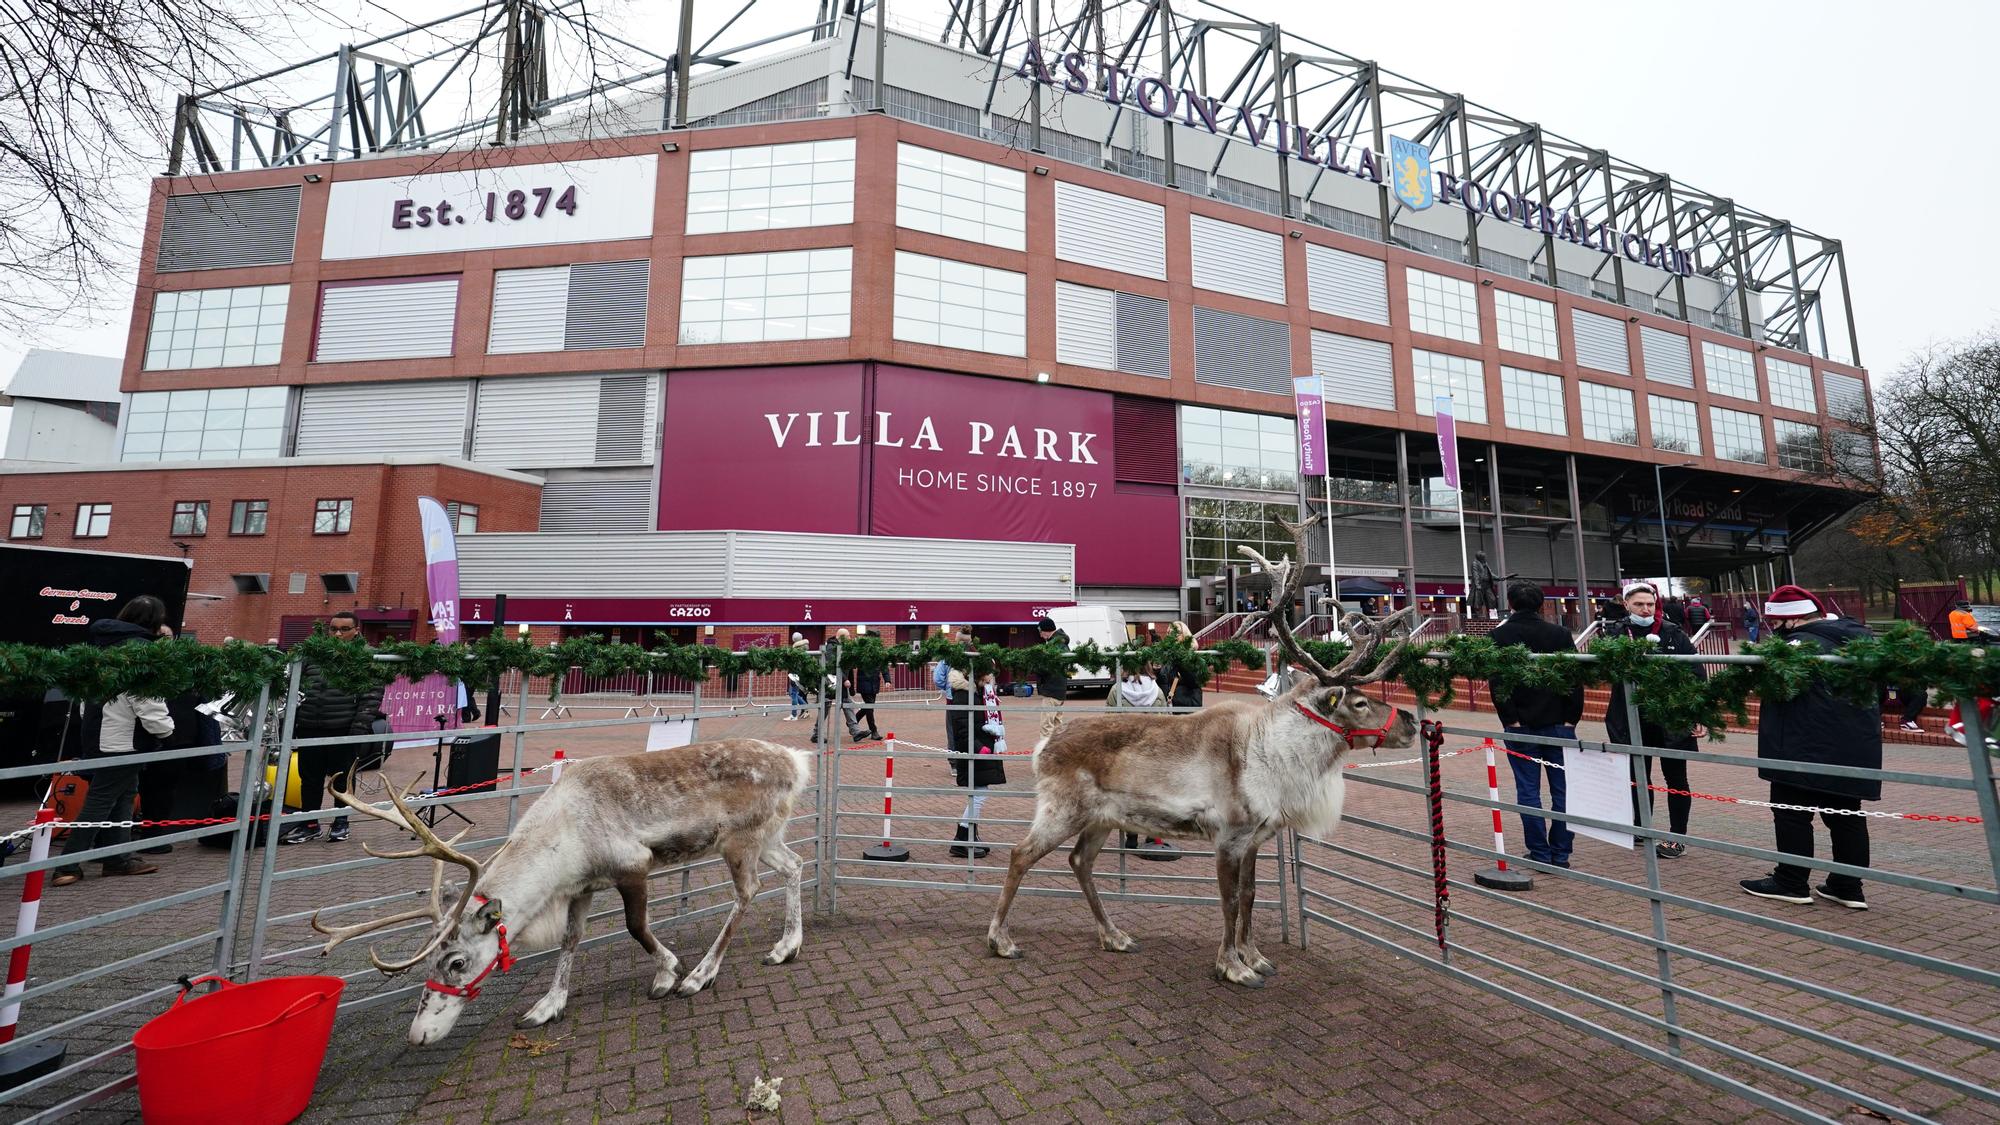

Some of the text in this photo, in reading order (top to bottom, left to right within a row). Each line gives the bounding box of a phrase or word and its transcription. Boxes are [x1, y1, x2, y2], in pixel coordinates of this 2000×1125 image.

[1016, 39, 1696, 278] ASTON VILLA FOOTBALL CLUB
[1395, 140, 1428, 160] AVFC
[392, 185, 578, 230] Est. 1874
[764, 411, 1099, 465] VILLA PARK
[898, 468, 1099, 500] HOME SINCE 1897
[1674, 498, 1704, 518] Road
[40, 586, 117, 601] German Sausage
[52, 614, 89, 625] Brezels
[669, 607, 711, 617] CAZOO
[1032, 609, 1051, 618] CAZ
[387, 690, 445, 700] LCOME TO
[415, 703, 456, 716] PARK
